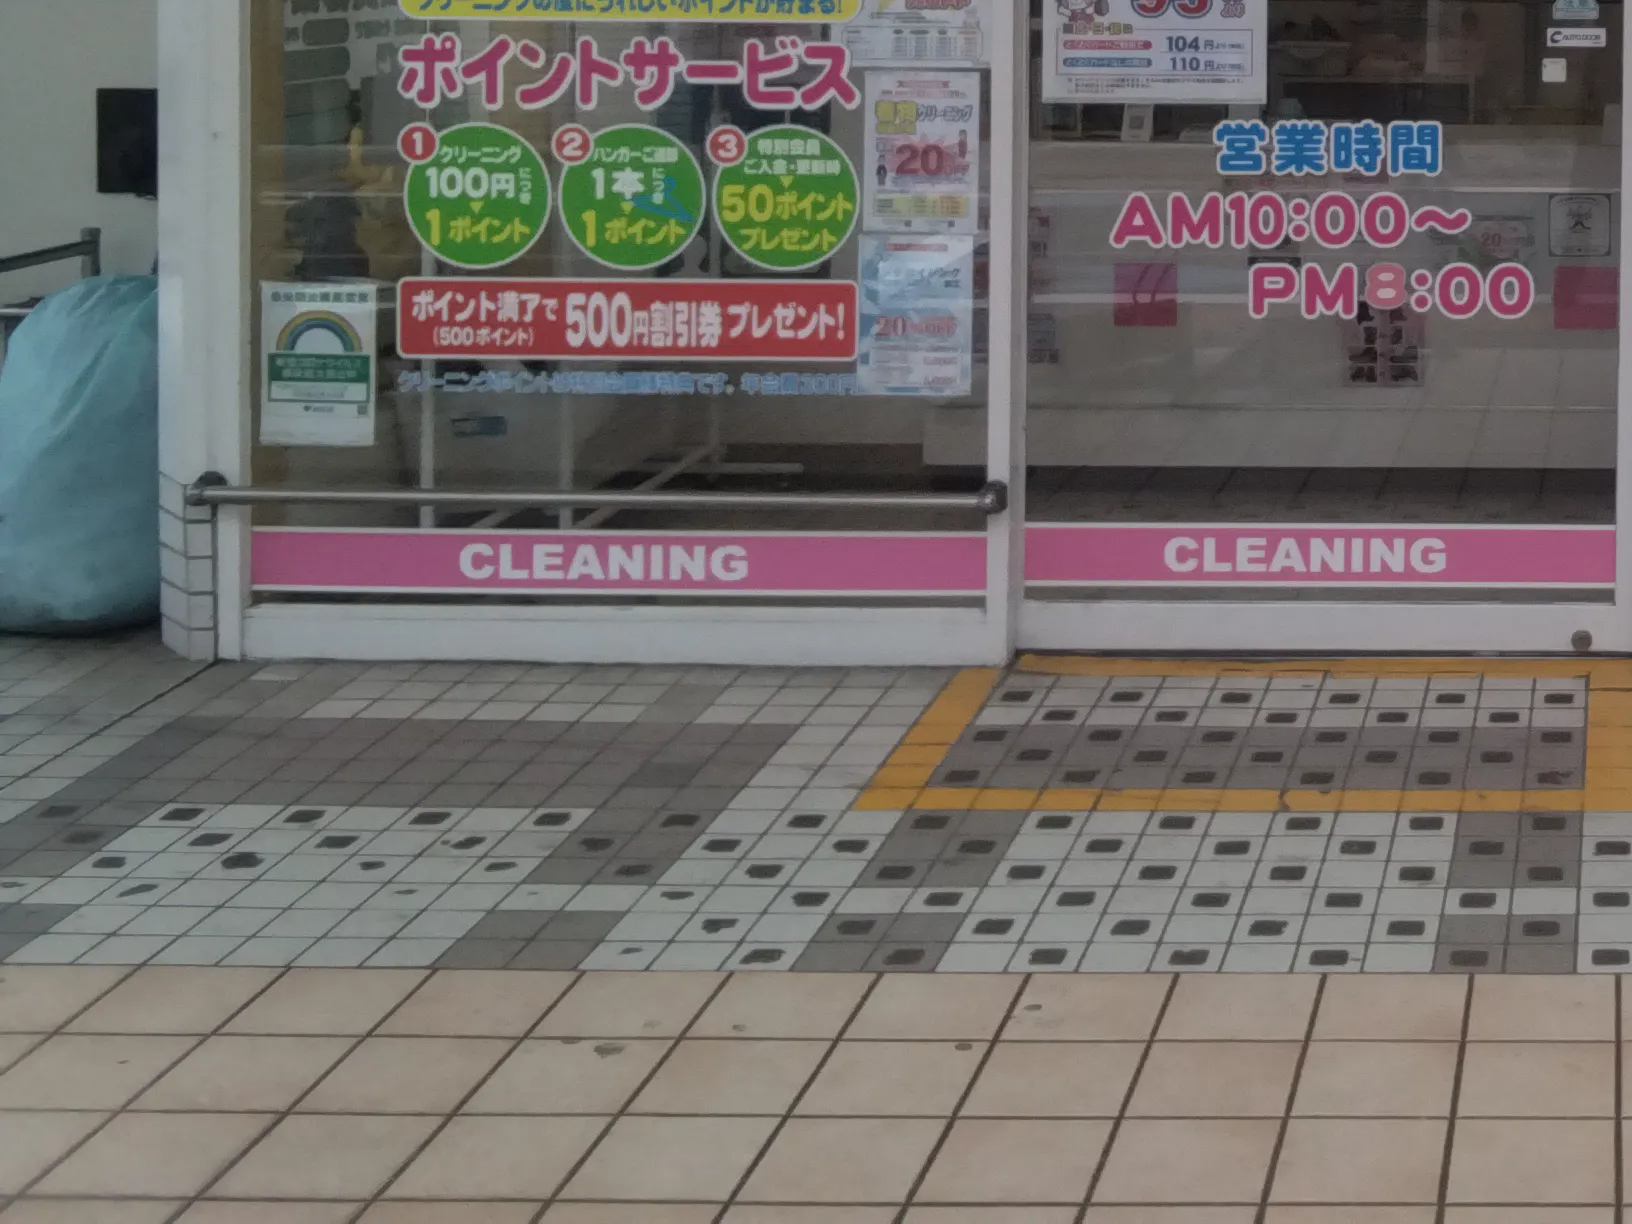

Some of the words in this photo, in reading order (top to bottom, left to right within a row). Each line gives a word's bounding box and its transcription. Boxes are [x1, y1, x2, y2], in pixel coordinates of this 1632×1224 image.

[1166, 36, 1200, 52] 104
[397, 33, 861, 111] ポイントサービス
[1170, 57, 1200, 71] 110
[439, 146, 522, 164] クリーニング
[562, 132, 583, 157] 2
[717, 133, 738, 158] 3
[1213, 120, 1443, 176] 営業時間
[425, 167, 515, 199] 100円
[721, 184, 853, 223] 50ポイント
[739, 228, 838, 252] プレゼント
[1248, 262, 1535, 319] PM8:00
[727, 302, 846, 341] プレゼント!
[458, 542, 750, 583] CLEANING
[1163, 535, 1447, 575] CLEANING
